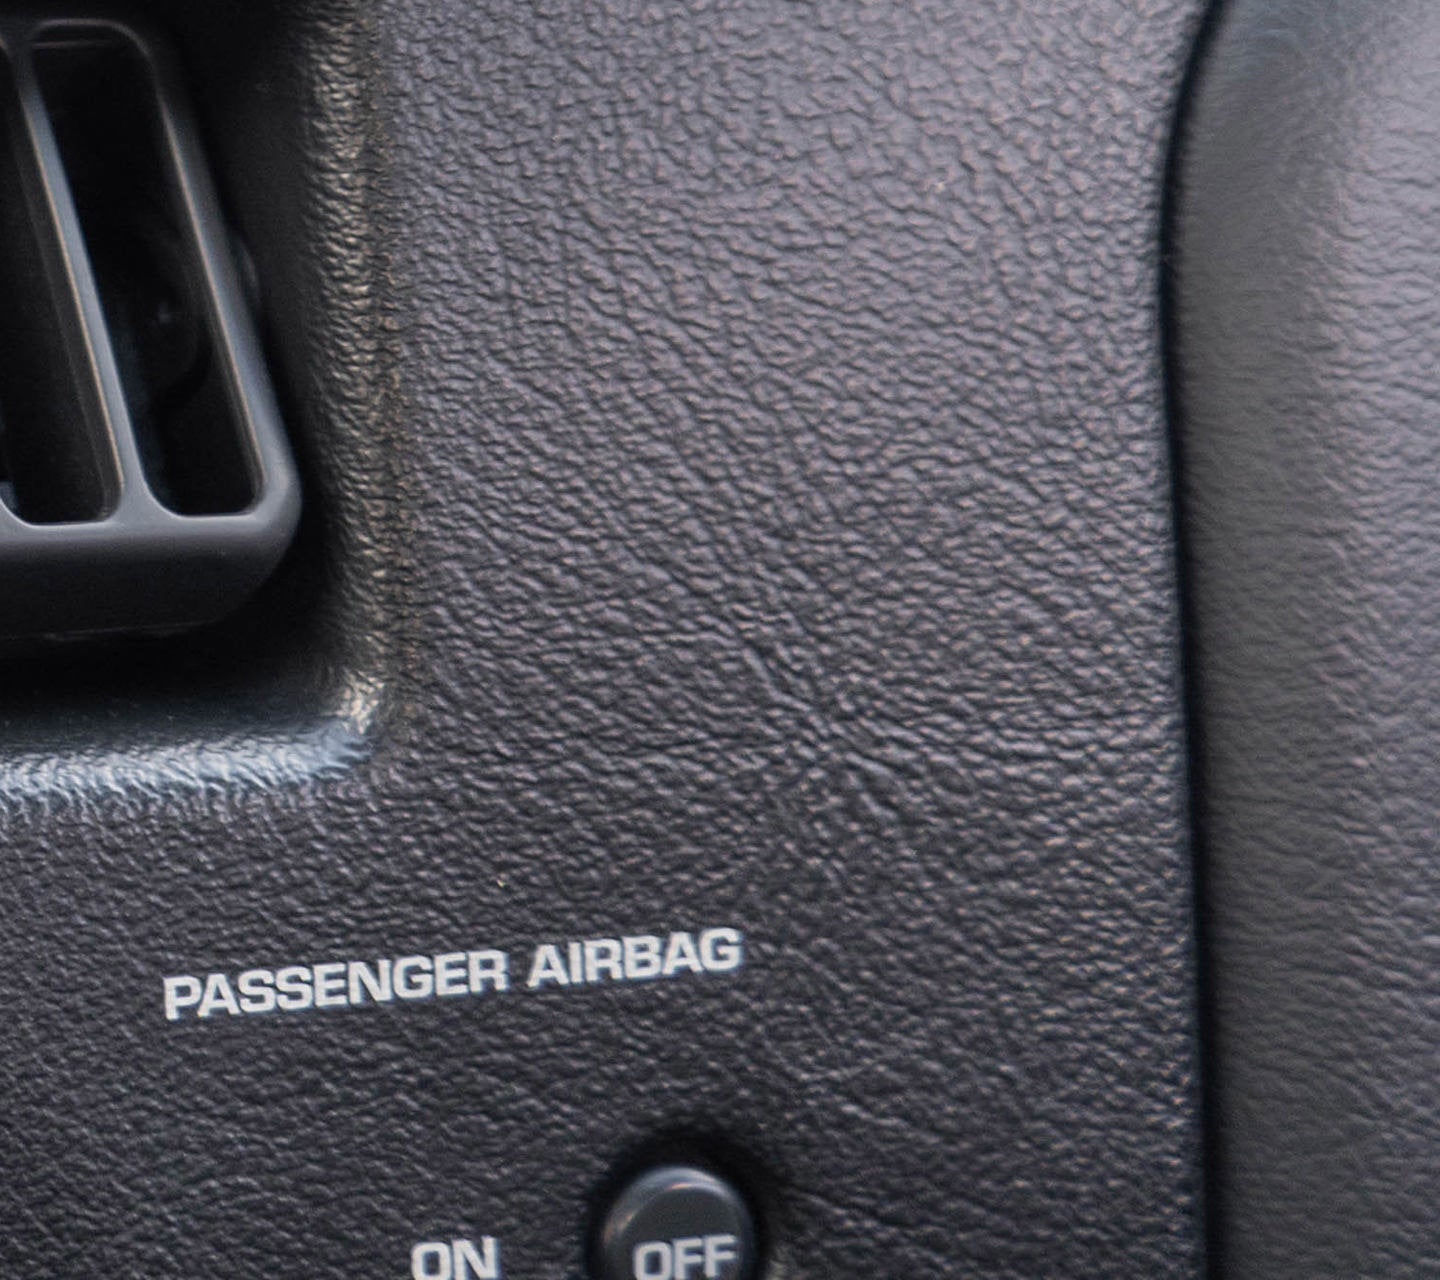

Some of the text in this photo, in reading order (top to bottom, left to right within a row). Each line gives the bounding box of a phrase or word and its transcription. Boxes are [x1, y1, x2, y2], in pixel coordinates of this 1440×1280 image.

[162, 927, 745, 1021] PASSENGER AIRBAG
[410, 1235, 501, 1280] ON
[634, 1233, 738, 1280] OFF
